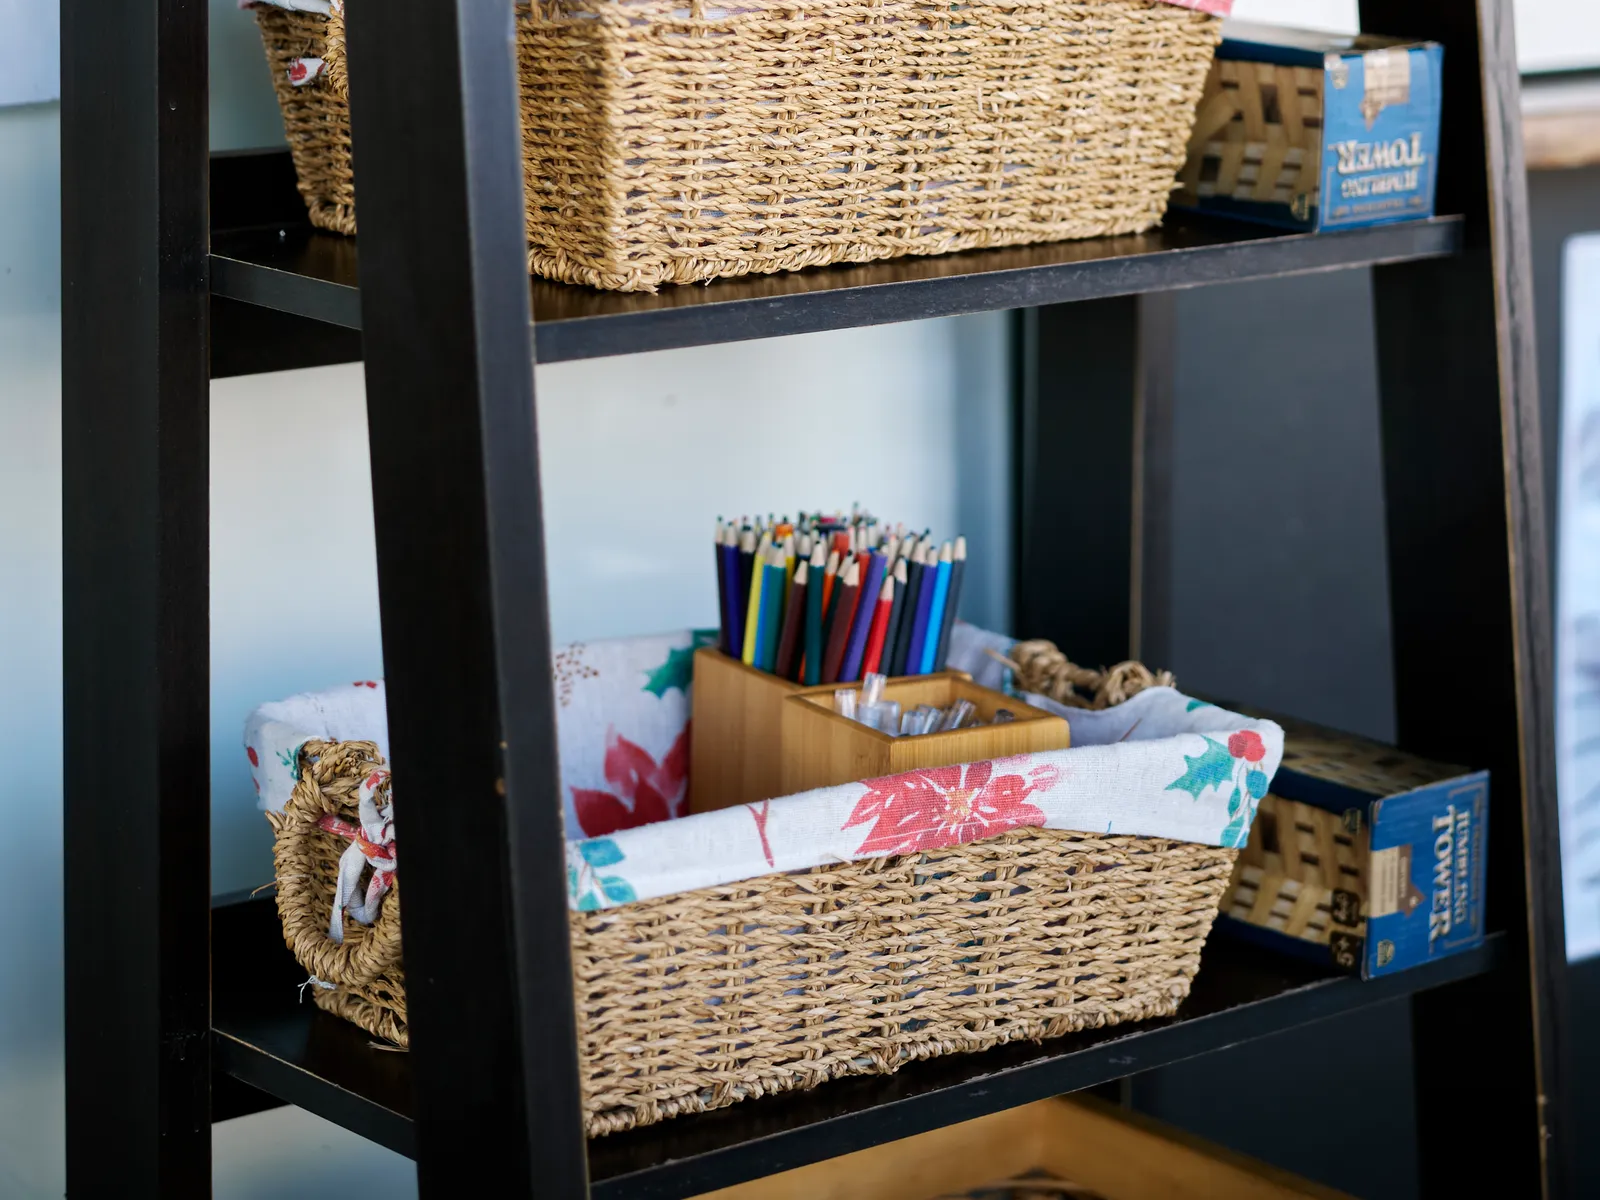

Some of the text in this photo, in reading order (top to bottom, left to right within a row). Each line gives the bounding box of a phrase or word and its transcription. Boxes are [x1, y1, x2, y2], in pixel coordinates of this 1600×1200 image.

[1337, 132, 1426, 175] TOWER
[1429, 804, 1456, 942] TOWER
[1454, 809, 1471, 925] JUMBLING
